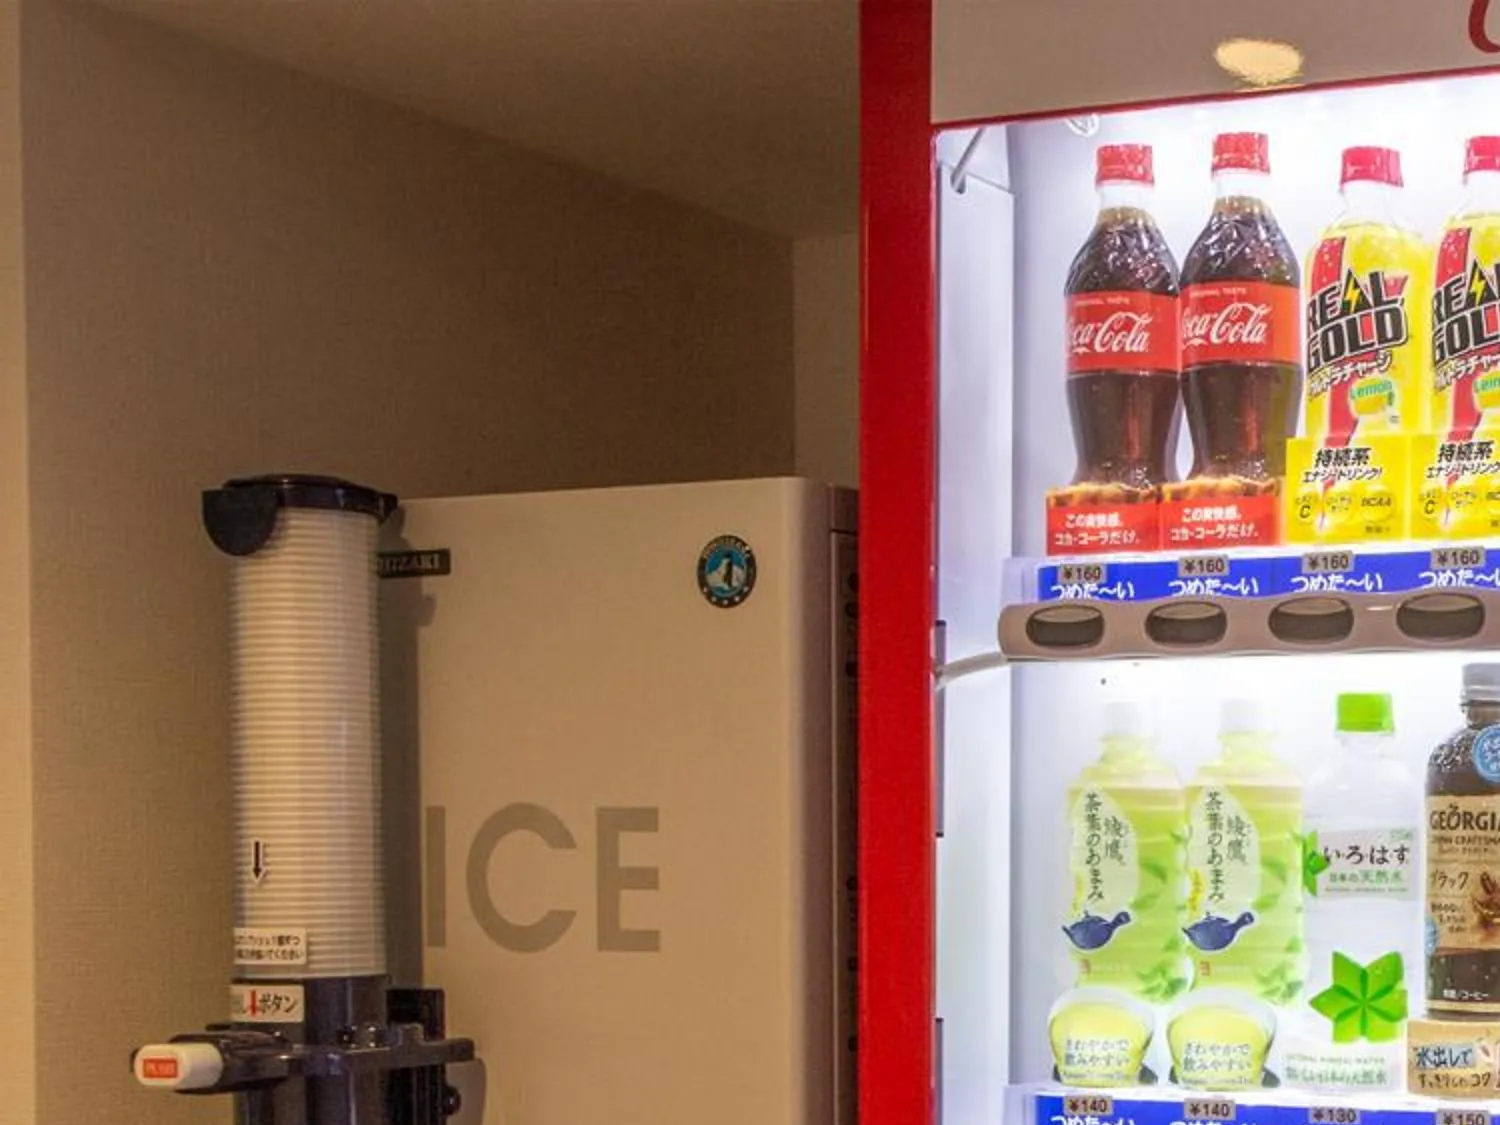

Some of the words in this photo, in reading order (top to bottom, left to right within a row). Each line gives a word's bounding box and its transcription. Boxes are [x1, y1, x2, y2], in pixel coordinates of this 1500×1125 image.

[1184, 557, 1226, 574] ¥160
[1308, 554, 1350, 570] ¥160
[1436, 549, 1481, 566] ¥160
[1062, 565, 1102, 581] ¥160
[424, 801, 661, 954] ICE
[1068, 1098, 1109, 1114] ¥140
[1188, 1102, 1231, 1118] ¥140
[1312, 1107, 1357, 1123] ¥130
